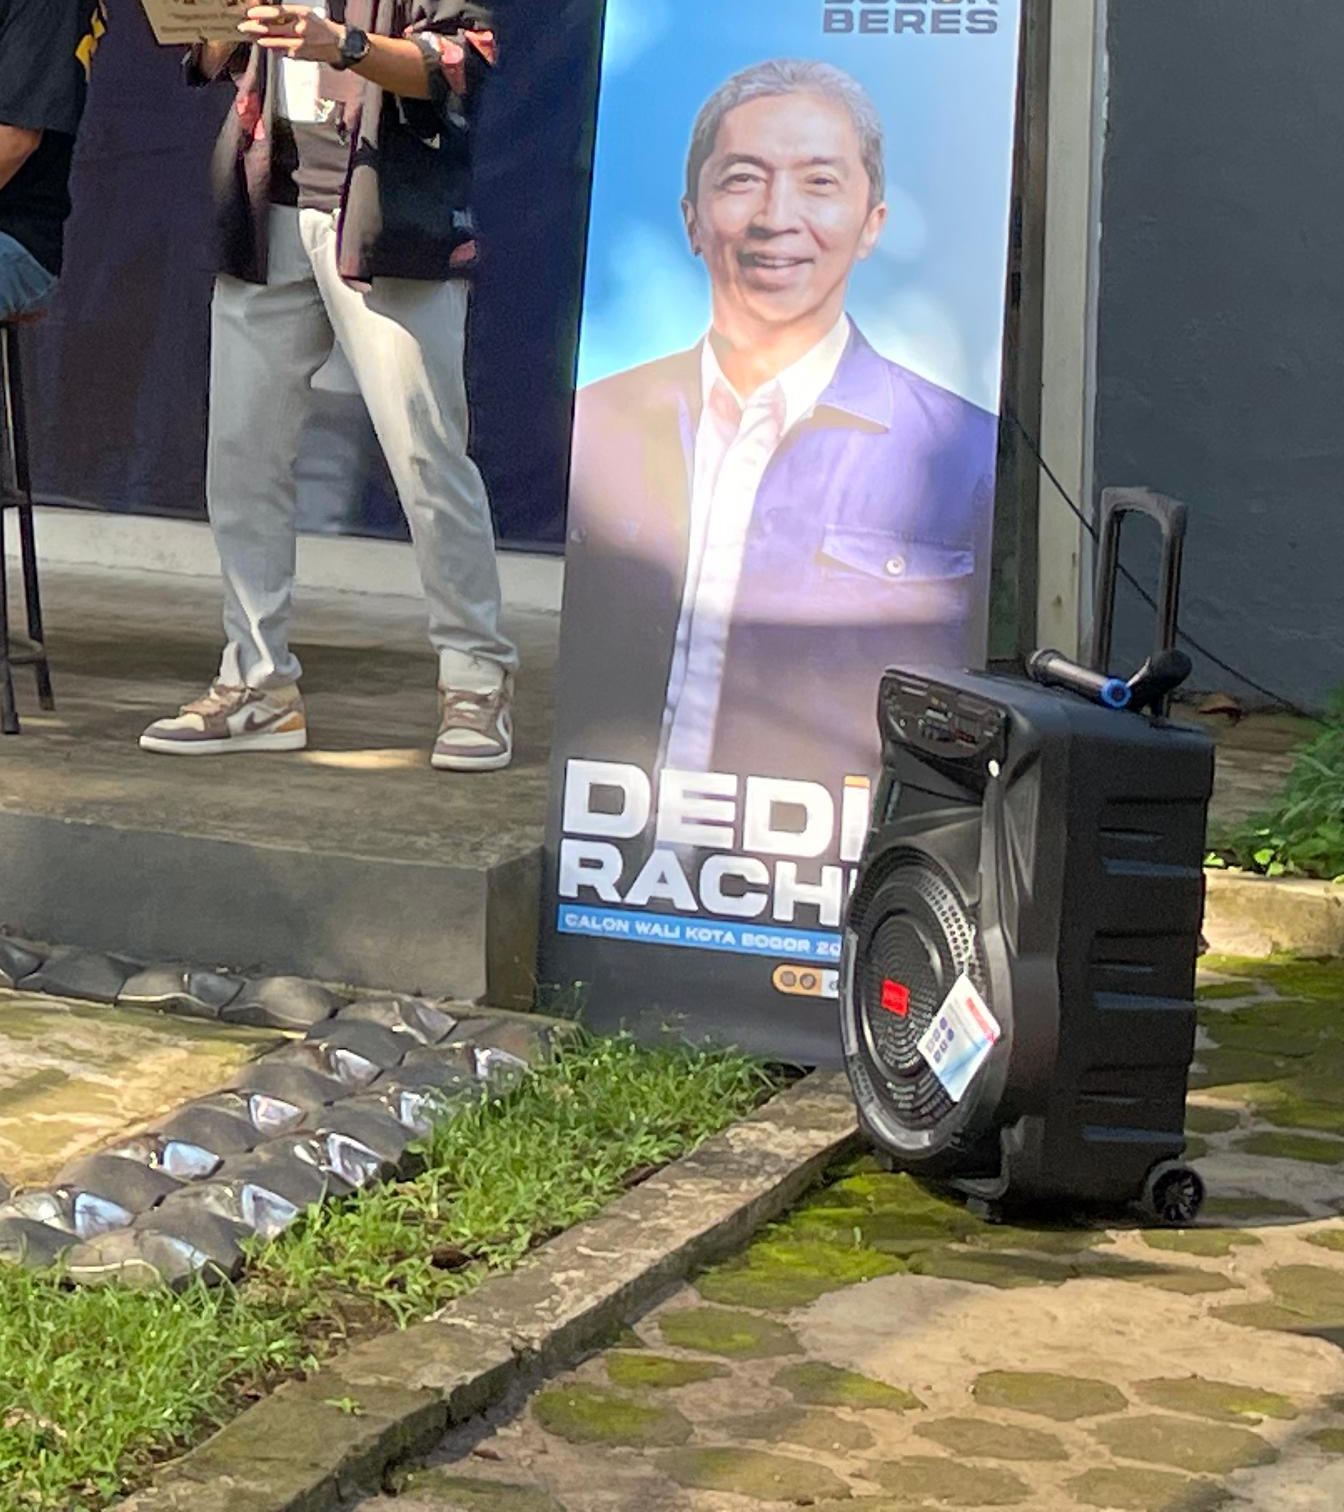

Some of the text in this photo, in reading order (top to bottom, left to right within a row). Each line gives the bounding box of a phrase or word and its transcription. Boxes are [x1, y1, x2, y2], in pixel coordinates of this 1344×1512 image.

[822, 8, 999, 35] BERES
[562, 758, 871, 863] DEDI
[558, 838, 859, 927] RACH
[564, 912, 630, 934] CALON
[635, 919, 681, 939] WALI
[685, 926, 737, 946] KOTA
[741, 932, 811, 953] BOGOR
